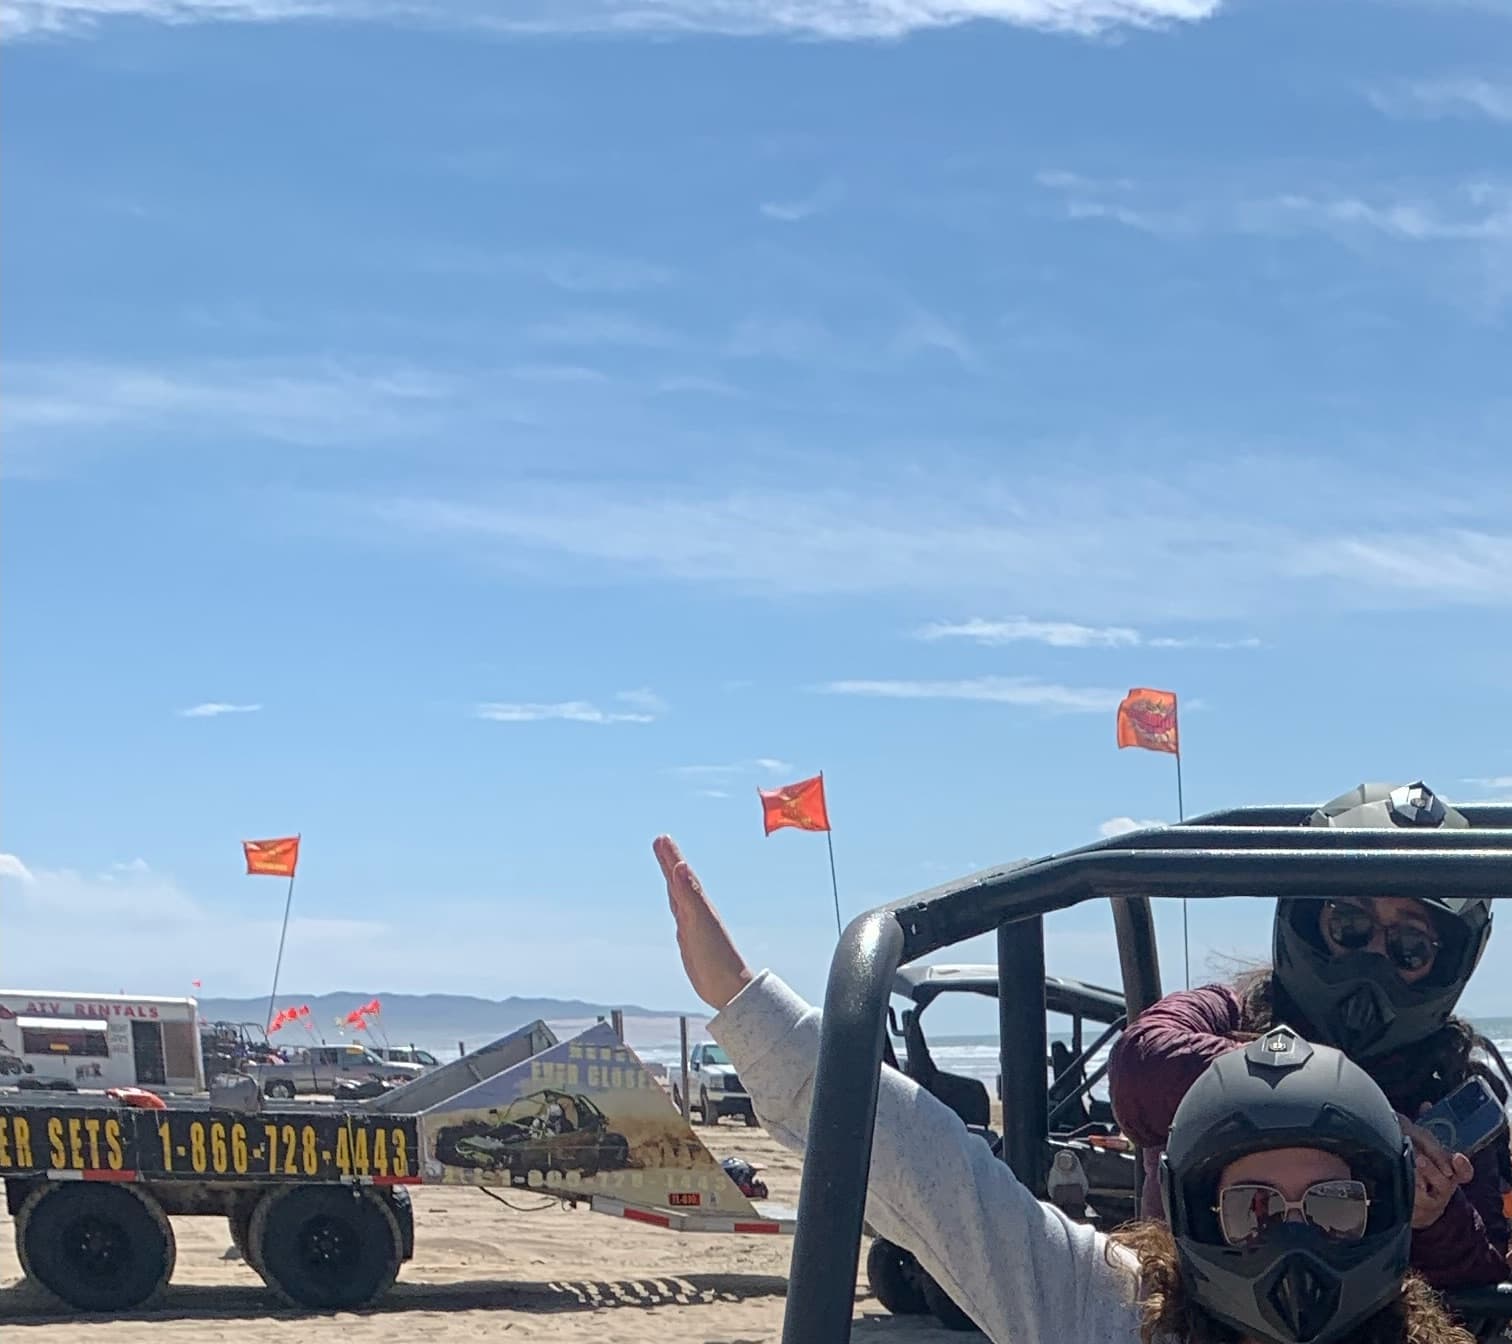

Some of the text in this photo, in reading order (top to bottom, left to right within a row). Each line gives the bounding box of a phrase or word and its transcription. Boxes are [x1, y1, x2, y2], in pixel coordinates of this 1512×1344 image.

[26, 1002, 159, 1018] ATV RENTALS
[47, 1117, 122, 1169] SETS
[158, 1121, 409, 1176] 1-866-728-4443
